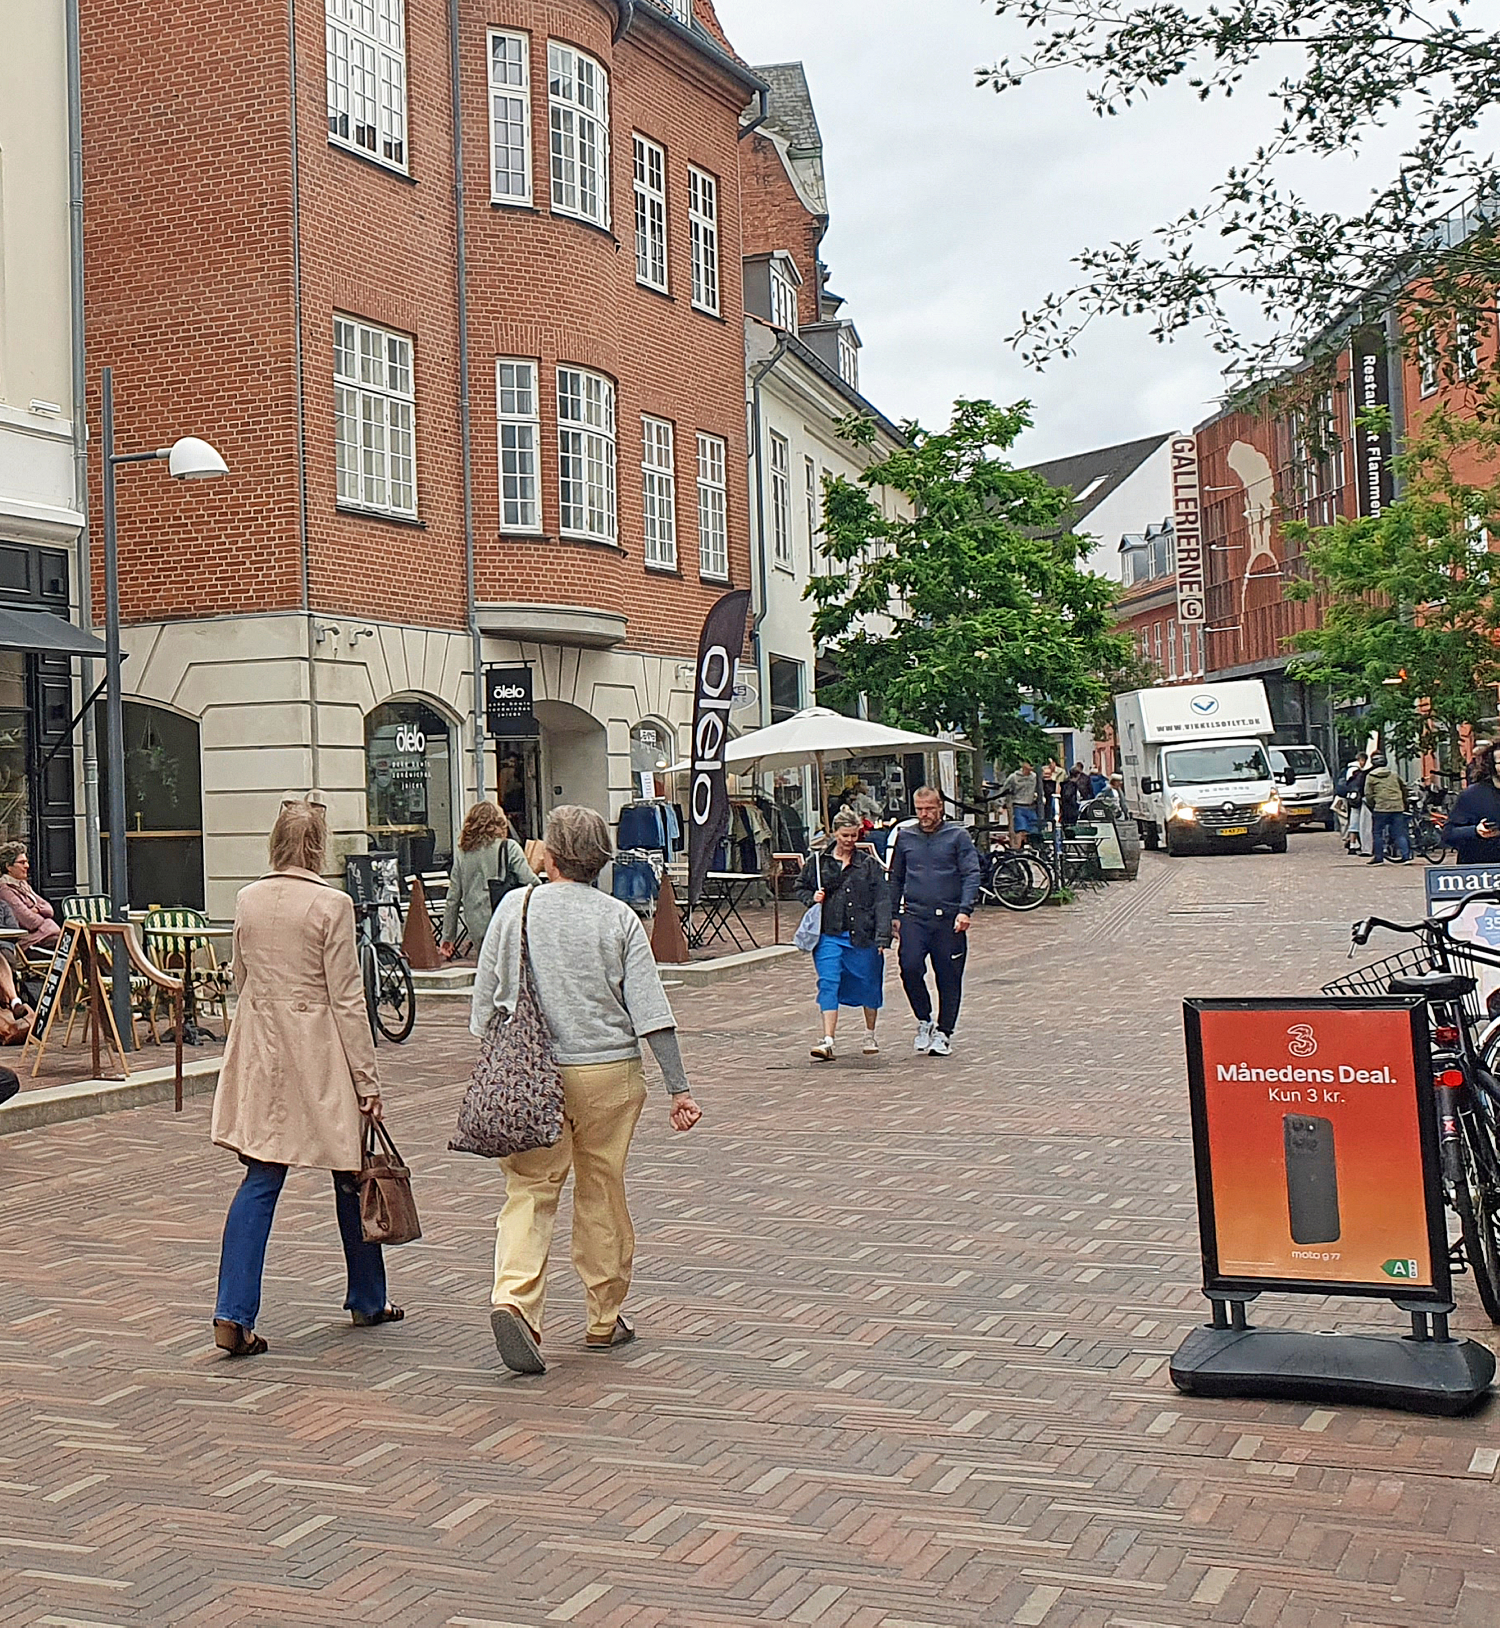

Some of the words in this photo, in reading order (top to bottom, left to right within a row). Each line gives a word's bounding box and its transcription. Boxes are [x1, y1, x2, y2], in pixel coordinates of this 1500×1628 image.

[1362, 355, 1380, 443] Restaut
[1172, 438, 1202, 594] GALLERIERNE
[1216, 1062, 1334, 1083] Månedens
[1338, 1065, 1397, 1084] Deal.
[1268, 1087, 1301, 1102] Kun
[1307, 1088, 1318, 1102] 3
[1323, 1088, 1345, 1103] kr.
[1291, 1250, 1320, 1260] moto
[1392, 1261, 1407, 1275] A
